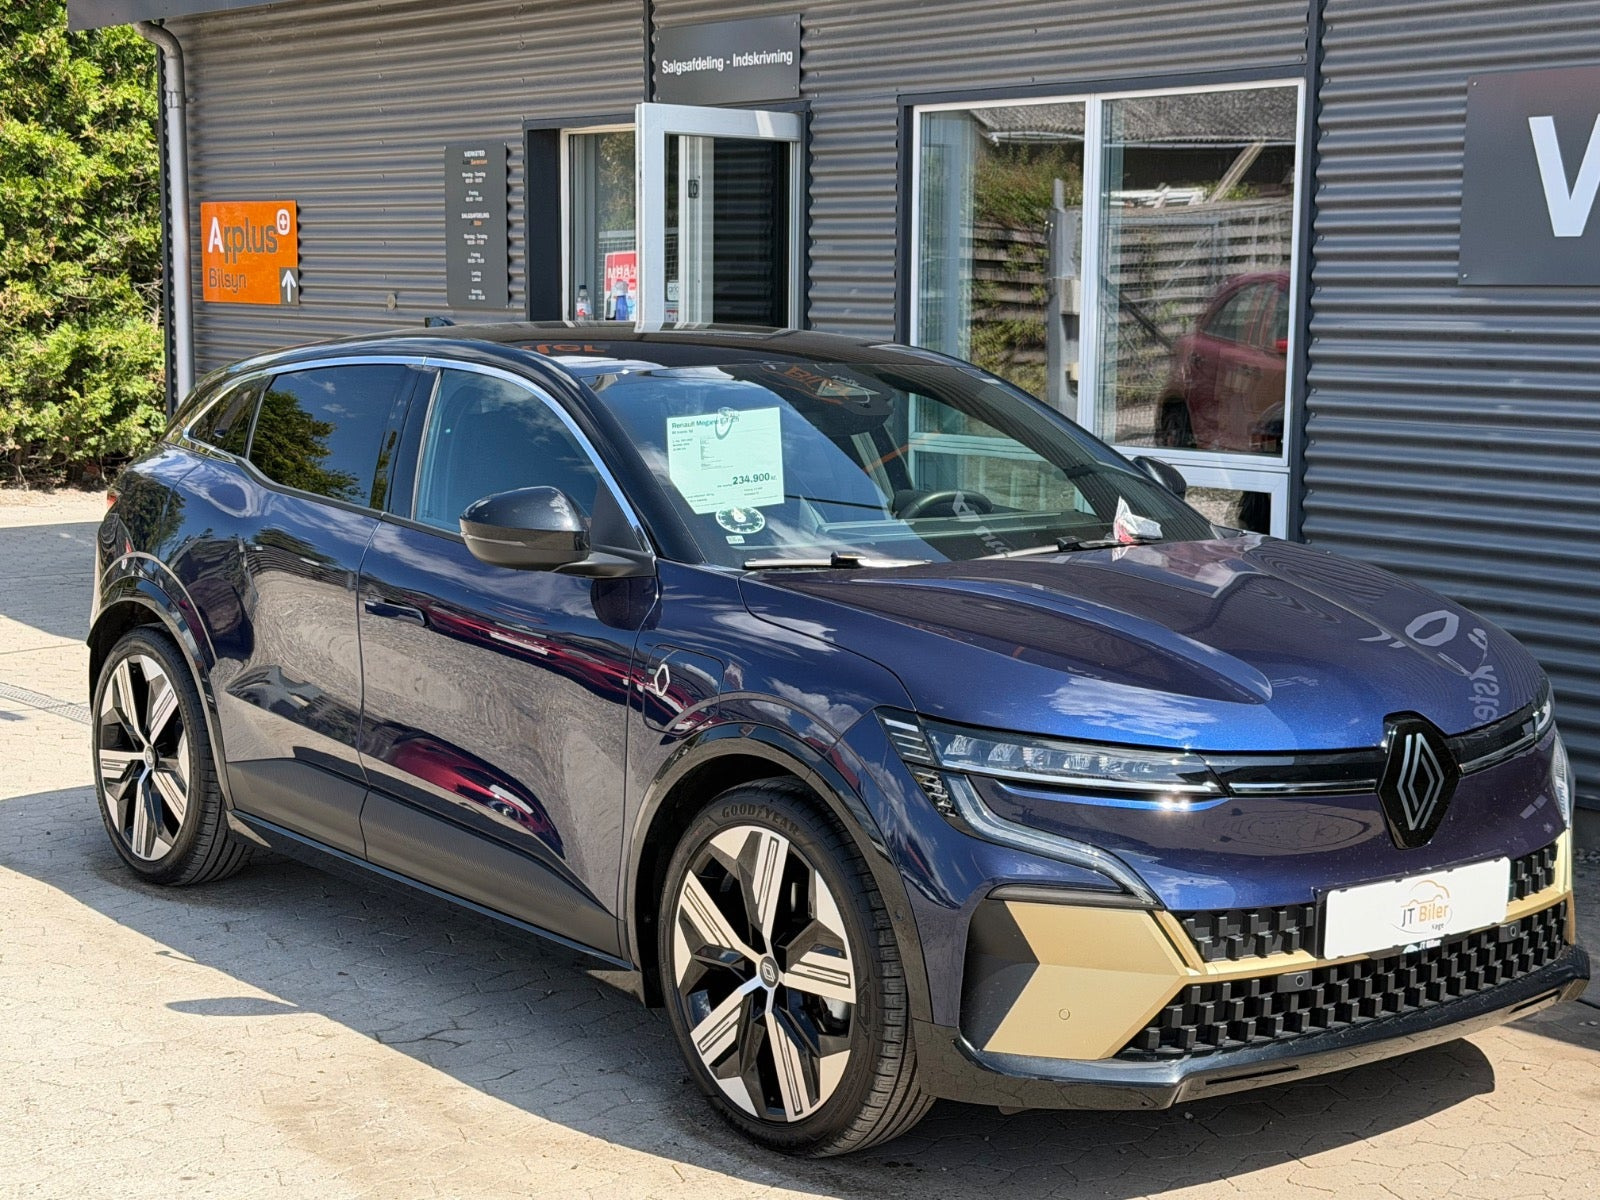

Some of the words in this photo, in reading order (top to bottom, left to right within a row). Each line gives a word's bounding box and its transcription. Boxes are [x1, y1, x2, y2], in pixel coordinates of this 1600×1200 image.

[661, 56, 724, 76] Salgsafdeling
[732, 49, 793, 67] Indskrivning
[209, 267, 247, 294] Bilsyn
[671, 420, 696, 429] Renault
[732, 472, 770, 485] 234.900
[1401, 908, 1415, 927] JT
[1419, 903, 1449, 922] Biler
